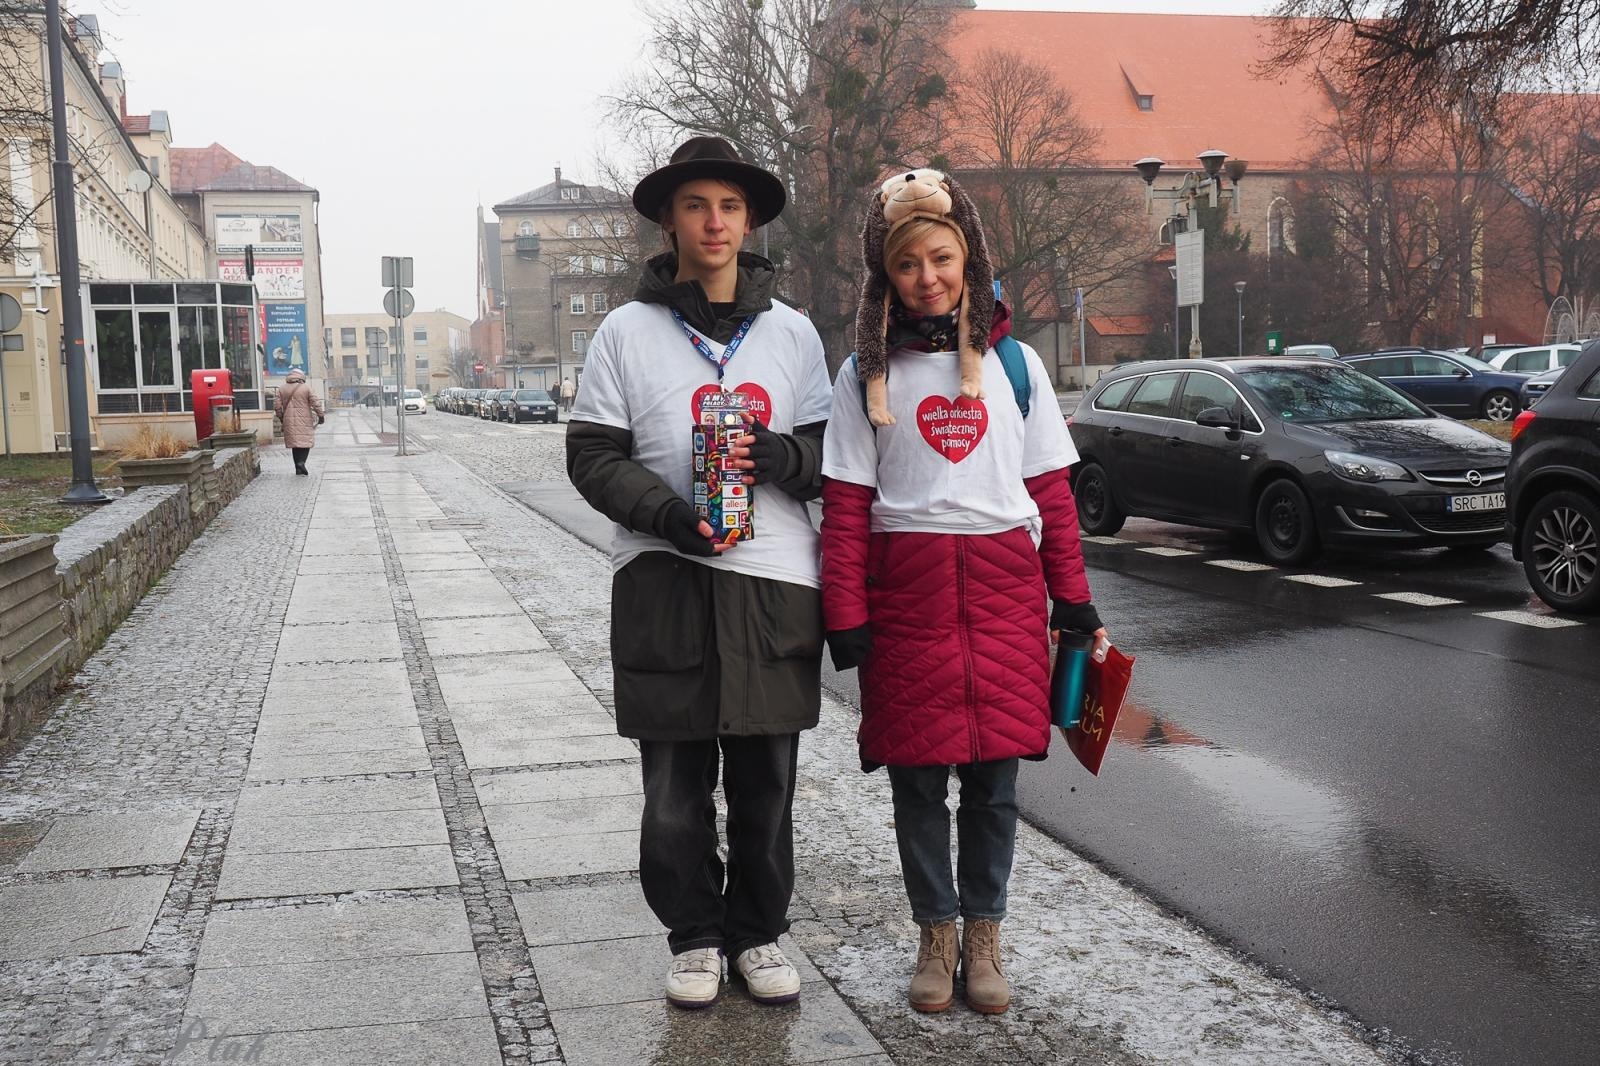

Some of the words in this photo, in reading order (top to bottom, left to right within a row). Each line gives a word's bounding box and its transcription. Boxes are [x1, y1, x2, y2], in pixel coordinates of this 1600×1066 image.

[223, 267, 300, 275] ALEANDER
[748, 395, 765, 411] stra
[922, 406, 948, 422] wielka
[949, 406, 982, 420] orkiestra
[930, 421, 978, 441] świątecznej
[941, 439, 971, 452] pomocy
[1454, 497, 1477, 510] SRC
[1481, 494, 1505, 508] TA19
